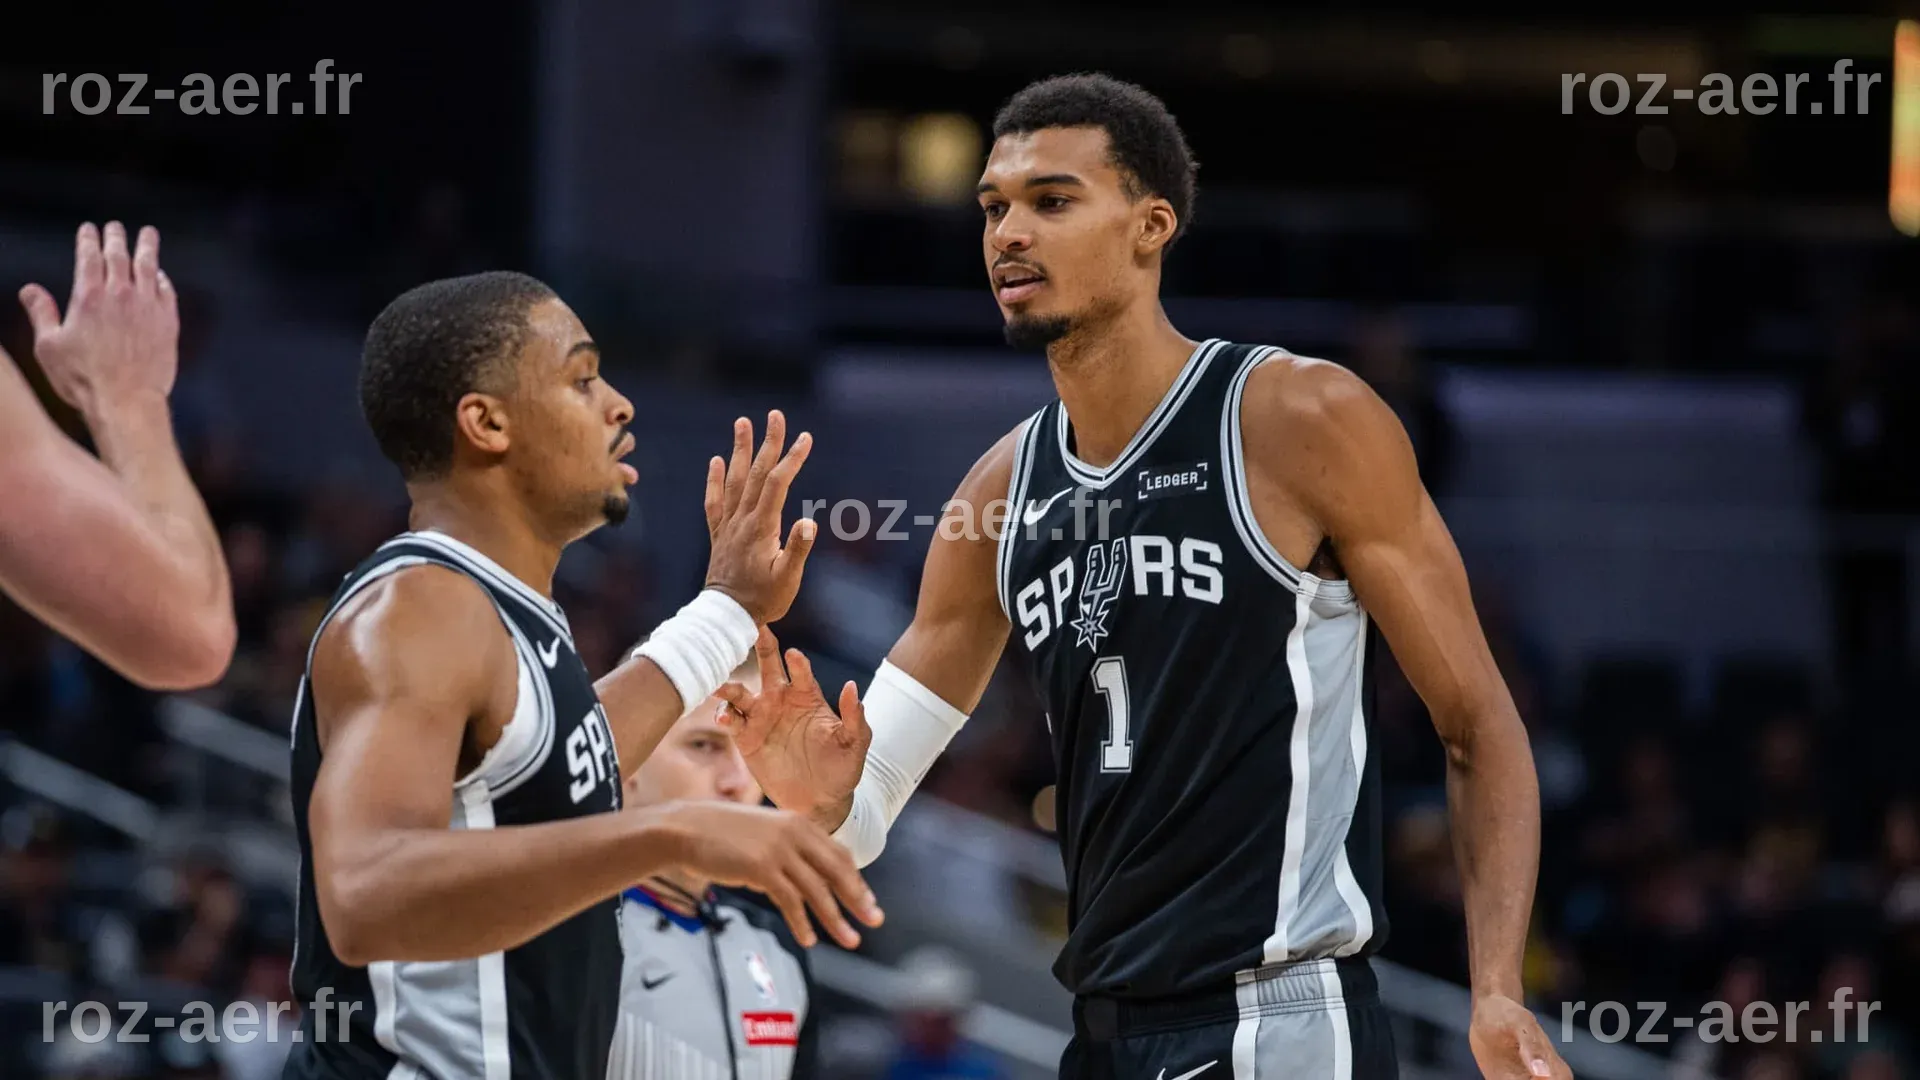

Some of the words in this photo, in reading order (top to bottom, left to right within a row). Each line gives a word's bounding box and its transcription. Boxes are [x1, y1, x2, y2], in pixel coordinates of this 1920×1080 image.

[1146, 471, 1198, 491] LEDGER
[1016, 535, 1224, 654] SPURS
[1090, 655, 1134, 773] 1
